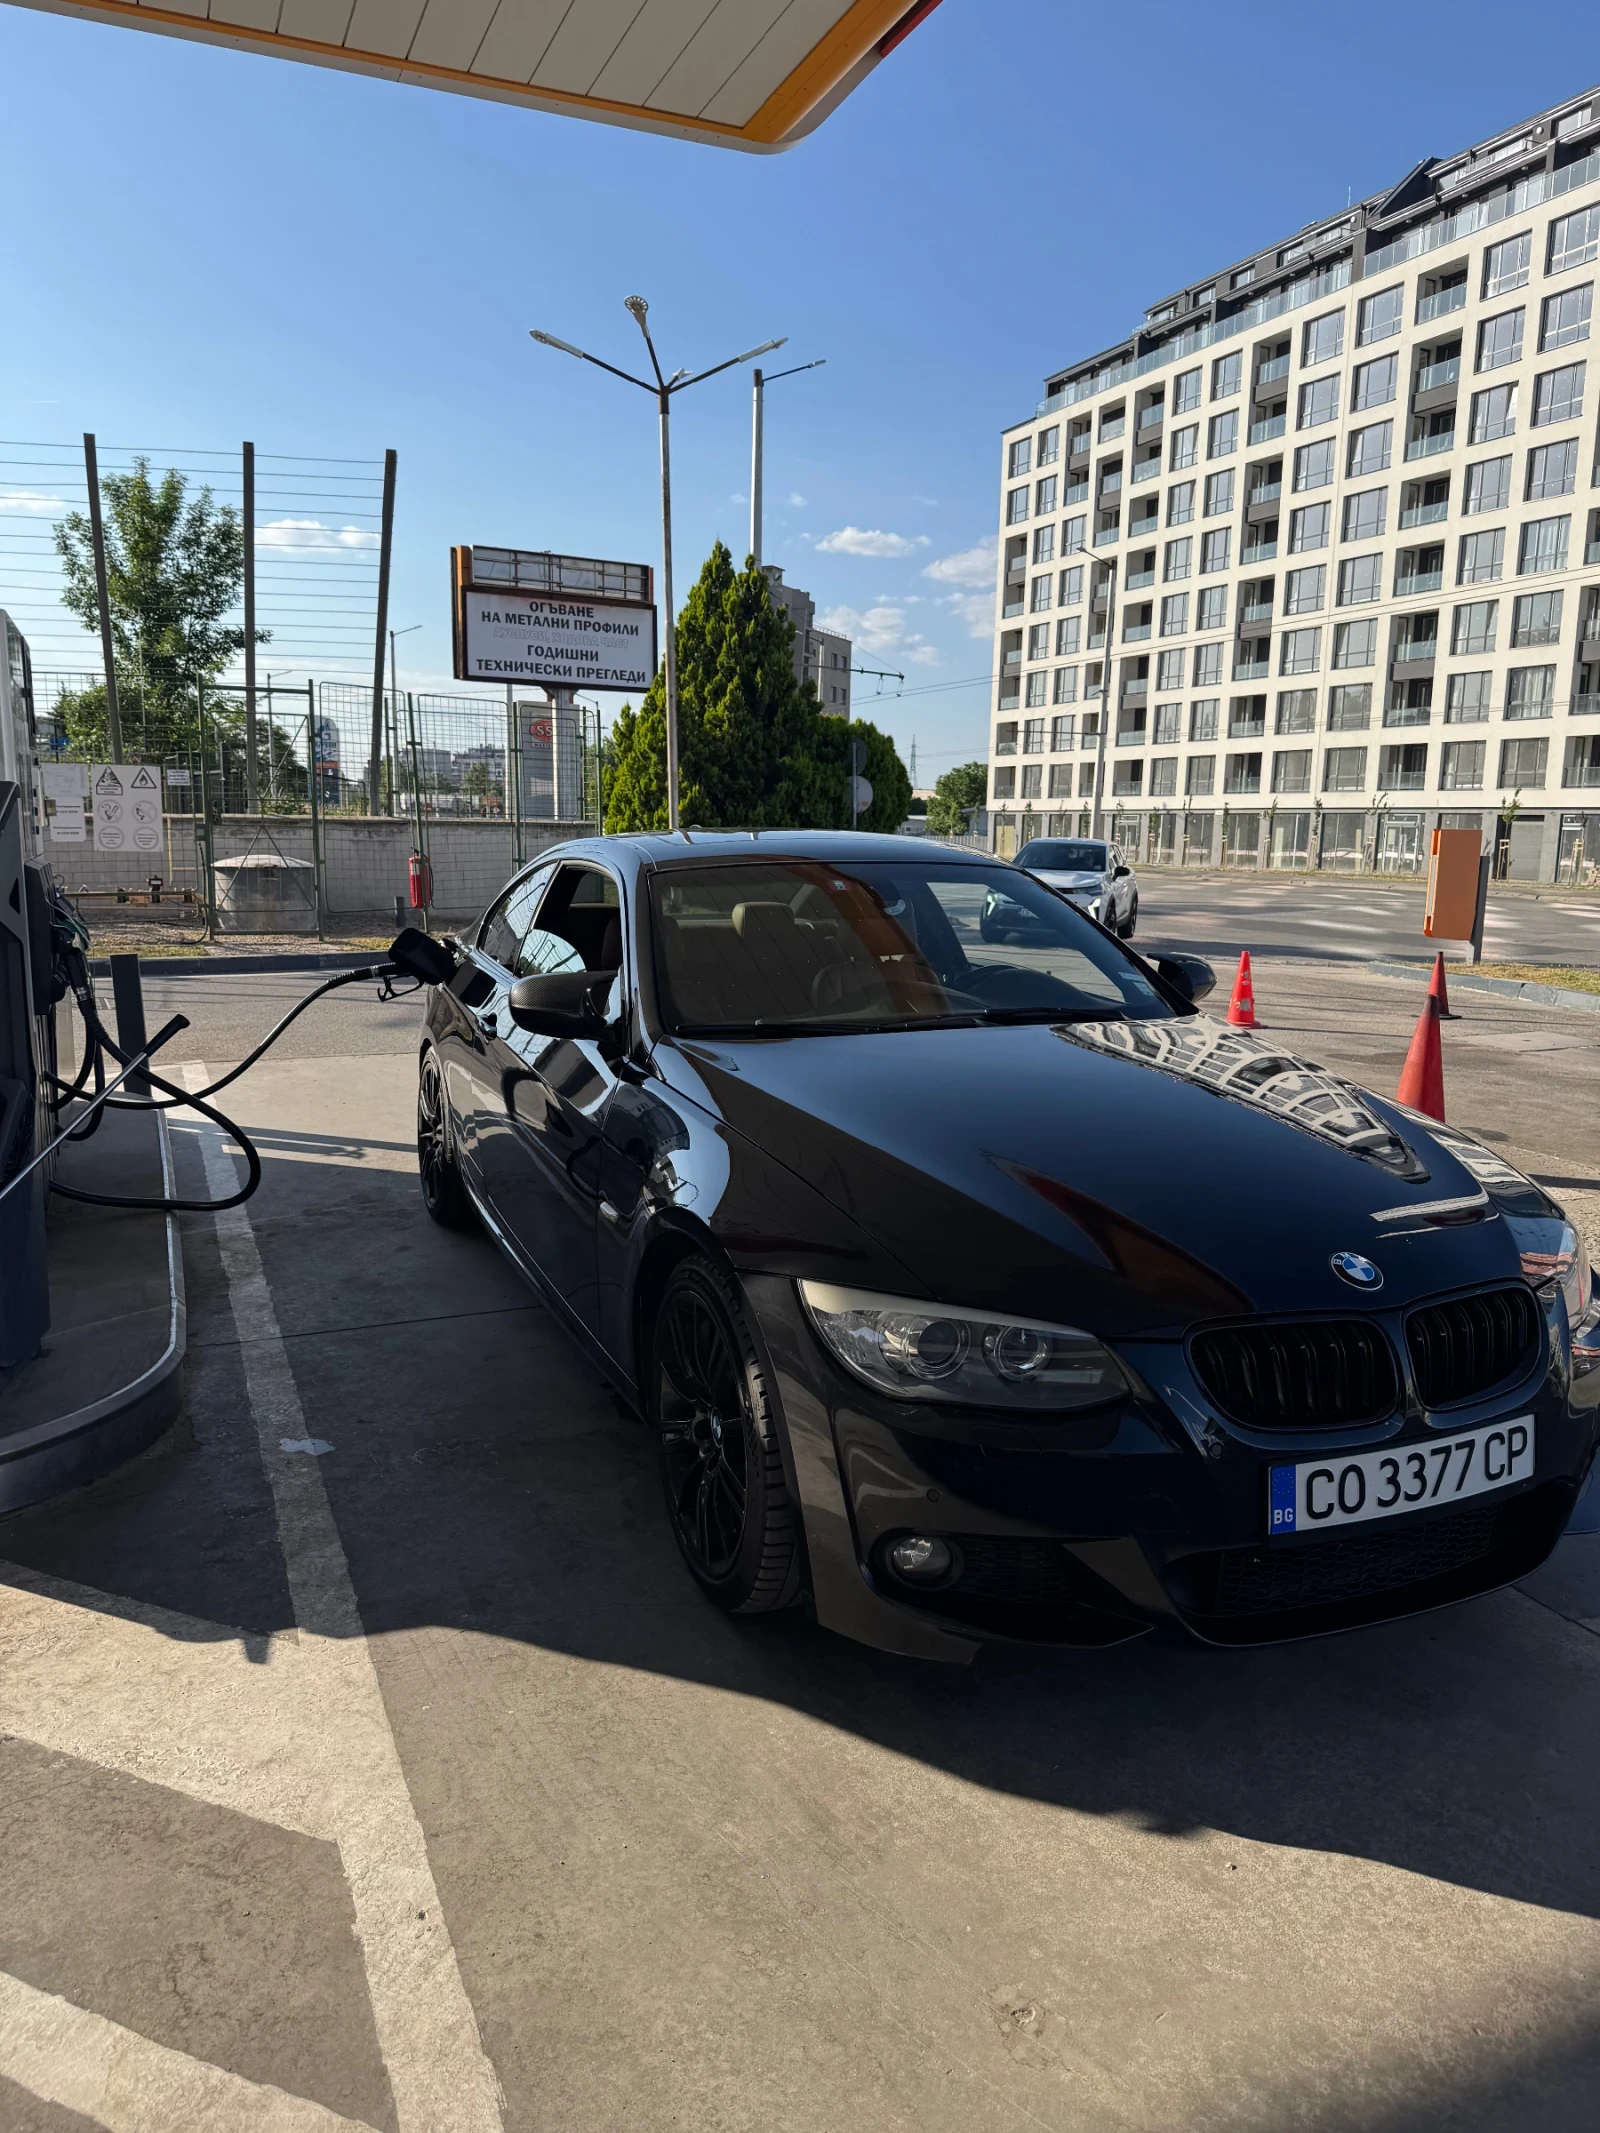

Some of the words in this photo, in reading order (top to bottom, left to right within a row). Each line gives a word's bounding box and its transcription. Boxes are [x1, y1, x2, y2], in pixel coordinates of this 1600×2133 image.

[529, 601, 594, 618] ОГЪВАНЕ
[481, 610, 501, 623] НА
[505, 612, 570, 630] МЕТАЛНИ
[574, 619, 639, 636] ПРОФИЛИ
[527, 644, 599, 662] ГОДИШНИ
[476, 658, 572, 677] ТЕХНИЧЕСКИ
[576, 666, 646, 684] ПРЕГЛЕДИ
[1306, 1464, 1366, 1520] CO
[1377, 1438, 1476, 1508] 3377
[1484, 1425, 1528, 1482] CP
[1273, 1507, 1294, 1525] BG
